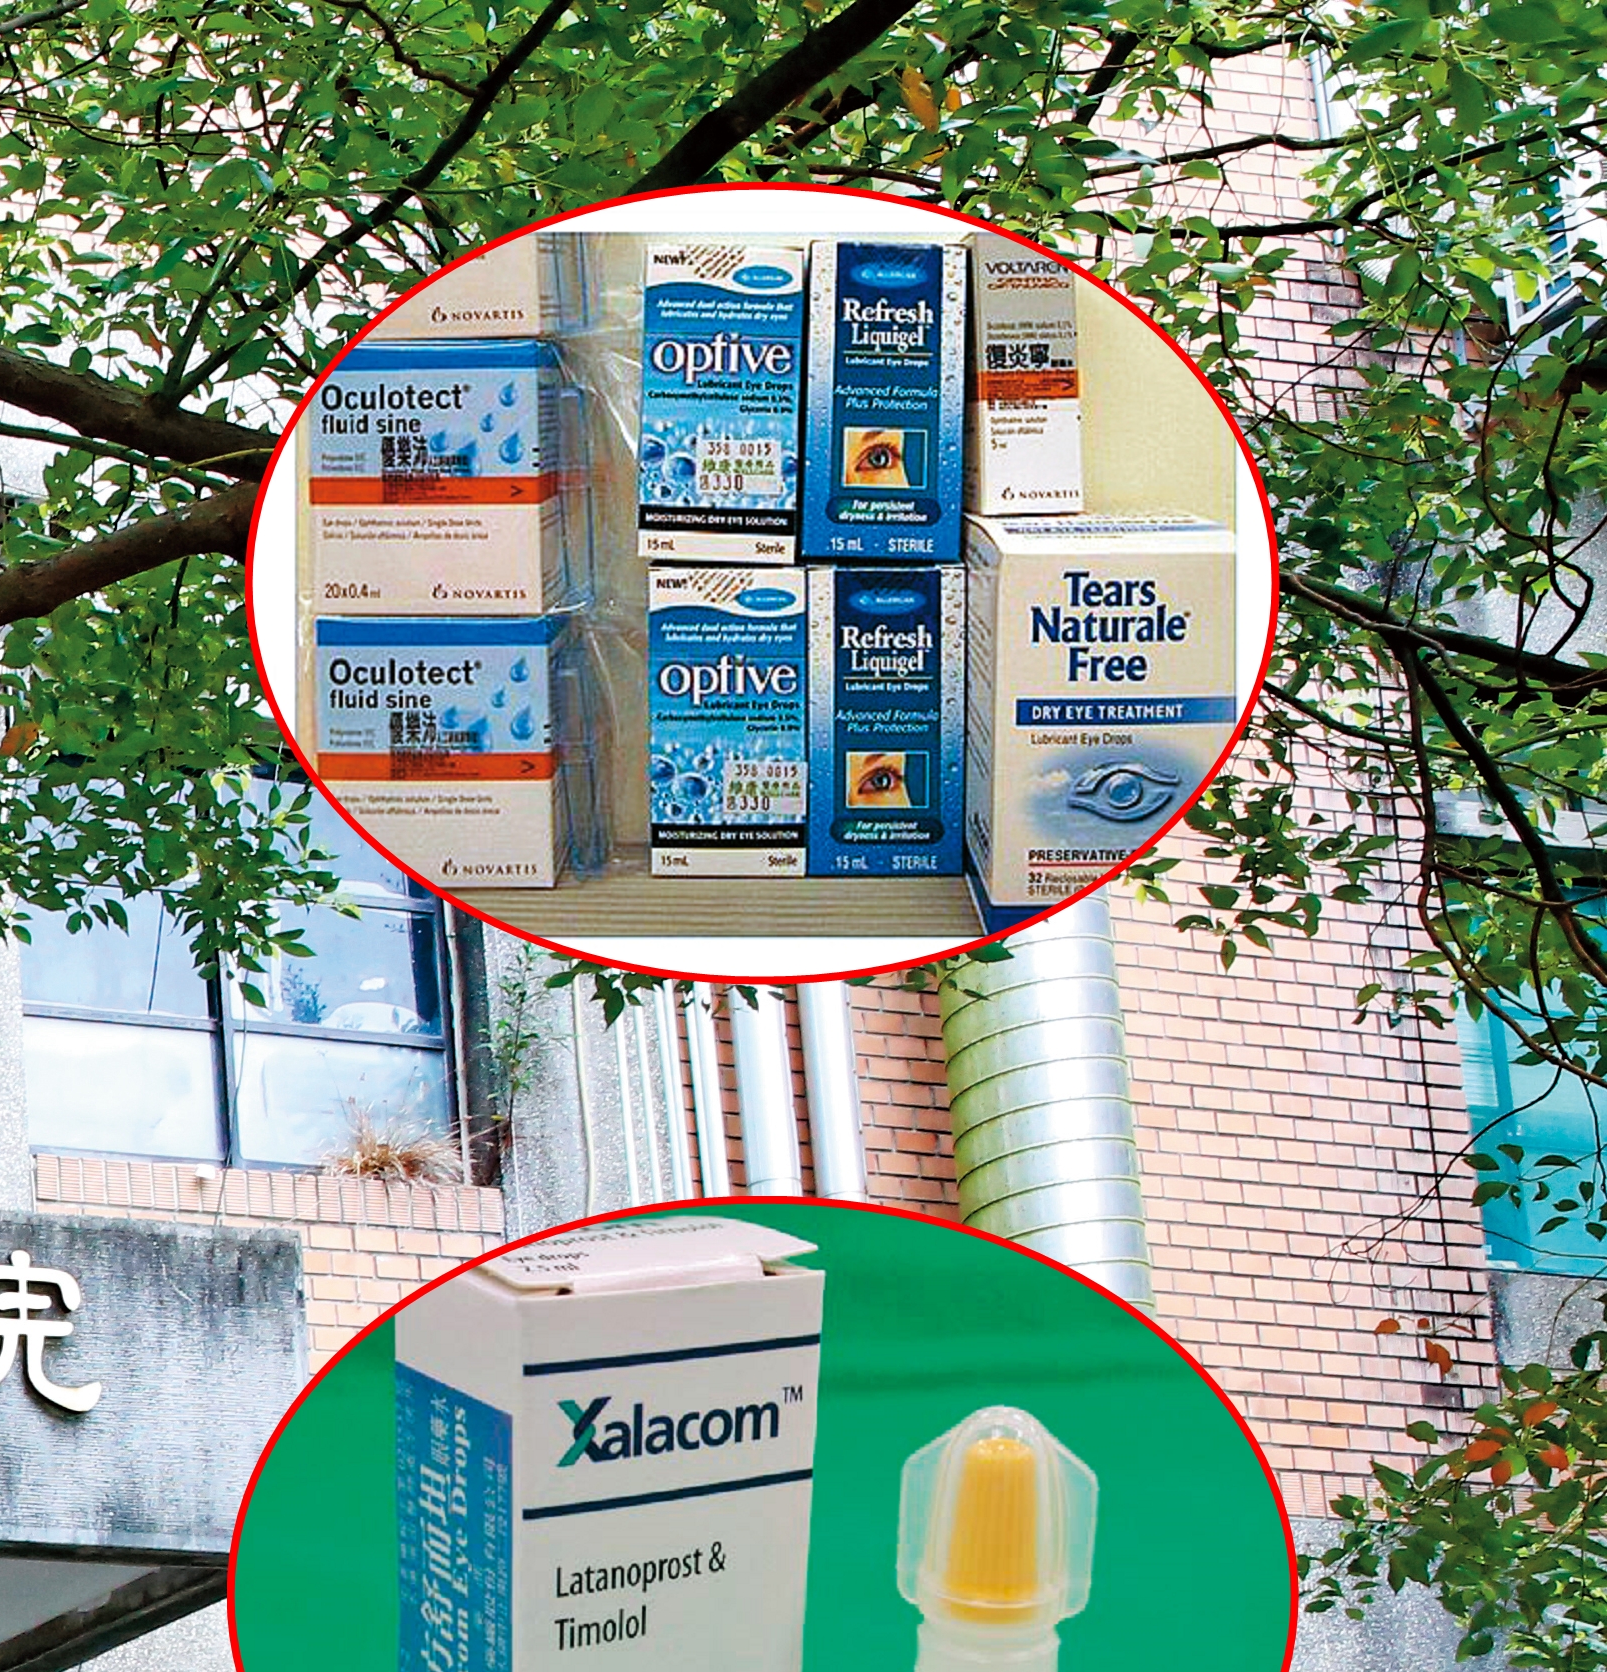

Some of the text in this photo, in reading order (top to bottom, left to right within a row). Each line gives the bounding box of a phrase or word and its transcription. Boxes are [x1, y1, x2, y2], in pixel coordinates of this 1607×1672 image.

[451, 310, 525, 322] NOVARTIS
[842, 297, 934, 325] Refresh
[851, 323, 925, 354] Liquigel
[653, 331, 792, 383] optive
[835, 386, 890, 396] Advanced
[846, 398, 928, 410] Plus Protection
[322, 414, 421, 434] fluid sine
[1019, 490, 1080, 499] NOVARTIS
[755, 542, 786, 554] Sterile
[889, 538, 934, 552] STERILE
[453, 590, 527, 600] NOVARTIS
[1063, 571, 1156, 608] Tears
[841, 625, 933, 649] Refresh
[851, 649, 925, 677] Liquigel
[1068, 647, 1148, 682] Free
[660, 653, 797, 705] optive
[329, 689, 432, 709] fluid sine
[836, 710, 890, 721] Advanced
[1032, 704, 1183, 720] DRY EYE TREATMENT
[847, 723, 929, 733] Plus Protection
[1031, 733, 1133, 747] Lubricant Eye Drops
[768, 855, 798, 867] Sterile
[892, 855, 937, 869] STERILE
[463, 864, 537, 876] NOVARTIS
[1029, 873, 1042, 884] 32
[1028, 885, 1072, 897] STERILE
[450, 1406, 471, 1517] Drops
[453, 1528, 472, 1598] Eye
[556, 1541, 727, 1599] Latanoprost &
[554, 1606, 647, 1651] Timolol
